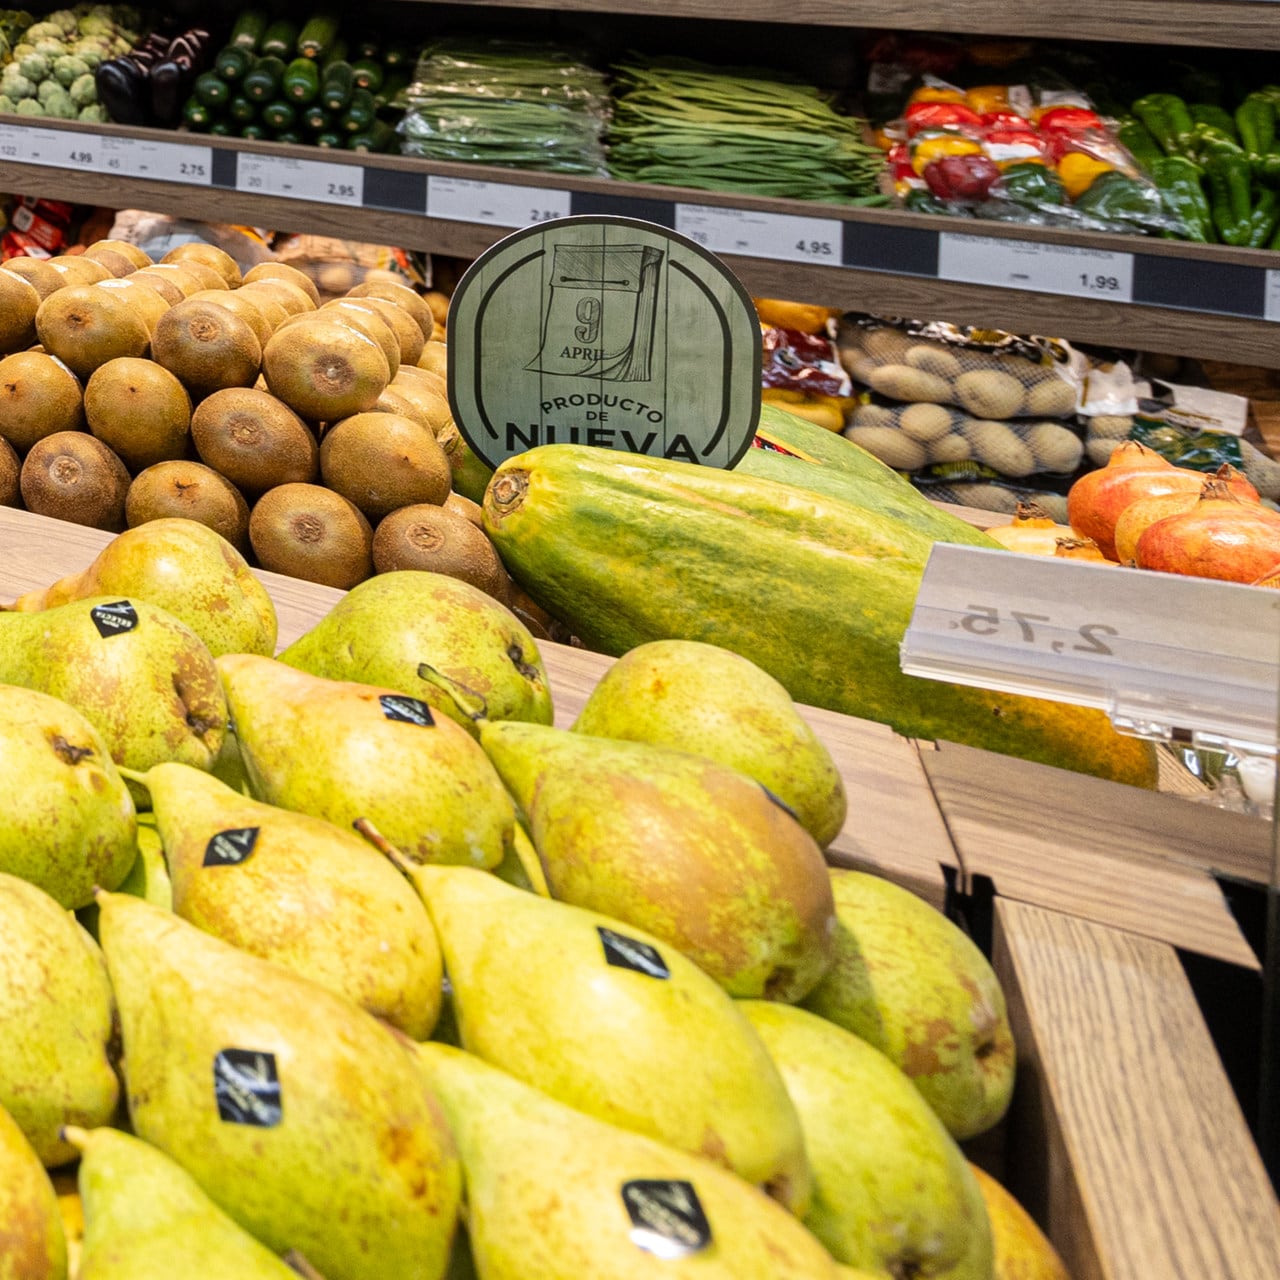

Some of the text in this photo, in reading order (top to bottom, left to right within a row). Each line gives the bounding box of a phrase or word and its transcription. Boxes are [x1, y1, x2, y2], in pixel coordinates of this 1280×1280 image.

[574, 296, 601, 344] 9
[559, 345, 606, 361] APRIL
[541, 392, 664, 424] PRODUCTO
[586, 410, 609, 422] DE
